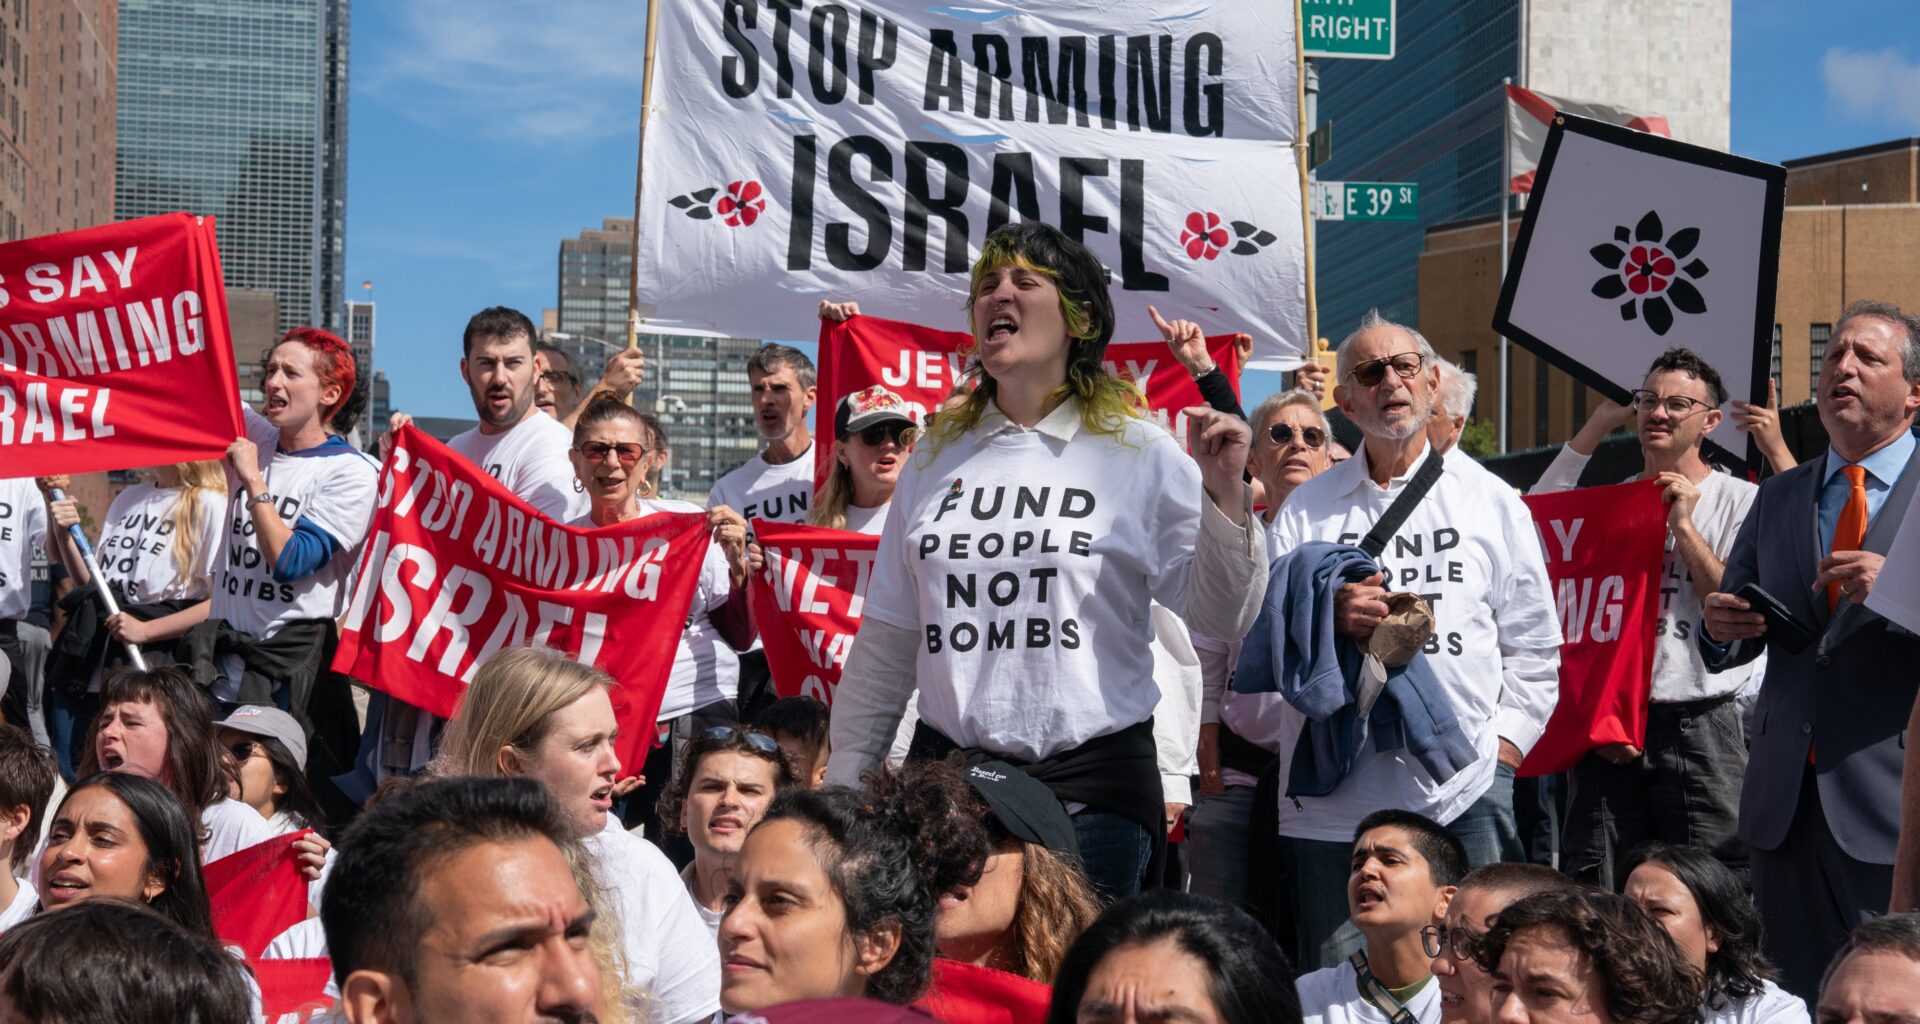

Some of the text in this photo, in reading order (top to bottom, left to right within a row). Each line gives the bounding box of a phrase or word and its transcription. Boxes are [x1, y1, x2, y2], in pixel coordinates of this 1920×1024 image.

[1310, 15, 1386, 41] RIGHT
[722, 0, 1224, 138] STOP ARMING
[788, 134, 1169, 291] ISRAEL
[1346, 187, 1412, 216] E 39 St
[25, 246, 138, 303] SAY
[882, 350, 983, 388] JEW
[743, 491, 807, 519] FUN
[933, 486, 1096, 522] FUND
[105, 534, 166, 557] EOLE
[473, 496, 670, 602] ARMING
[919, 528, 1094, 560] PEOPLE
[1337, 527, 1460, 558] FND
[100, 553, 141, 574] NO
[946, 567, 1057, 608] NOT
[926, 617, 1081, 654] BOMBS
